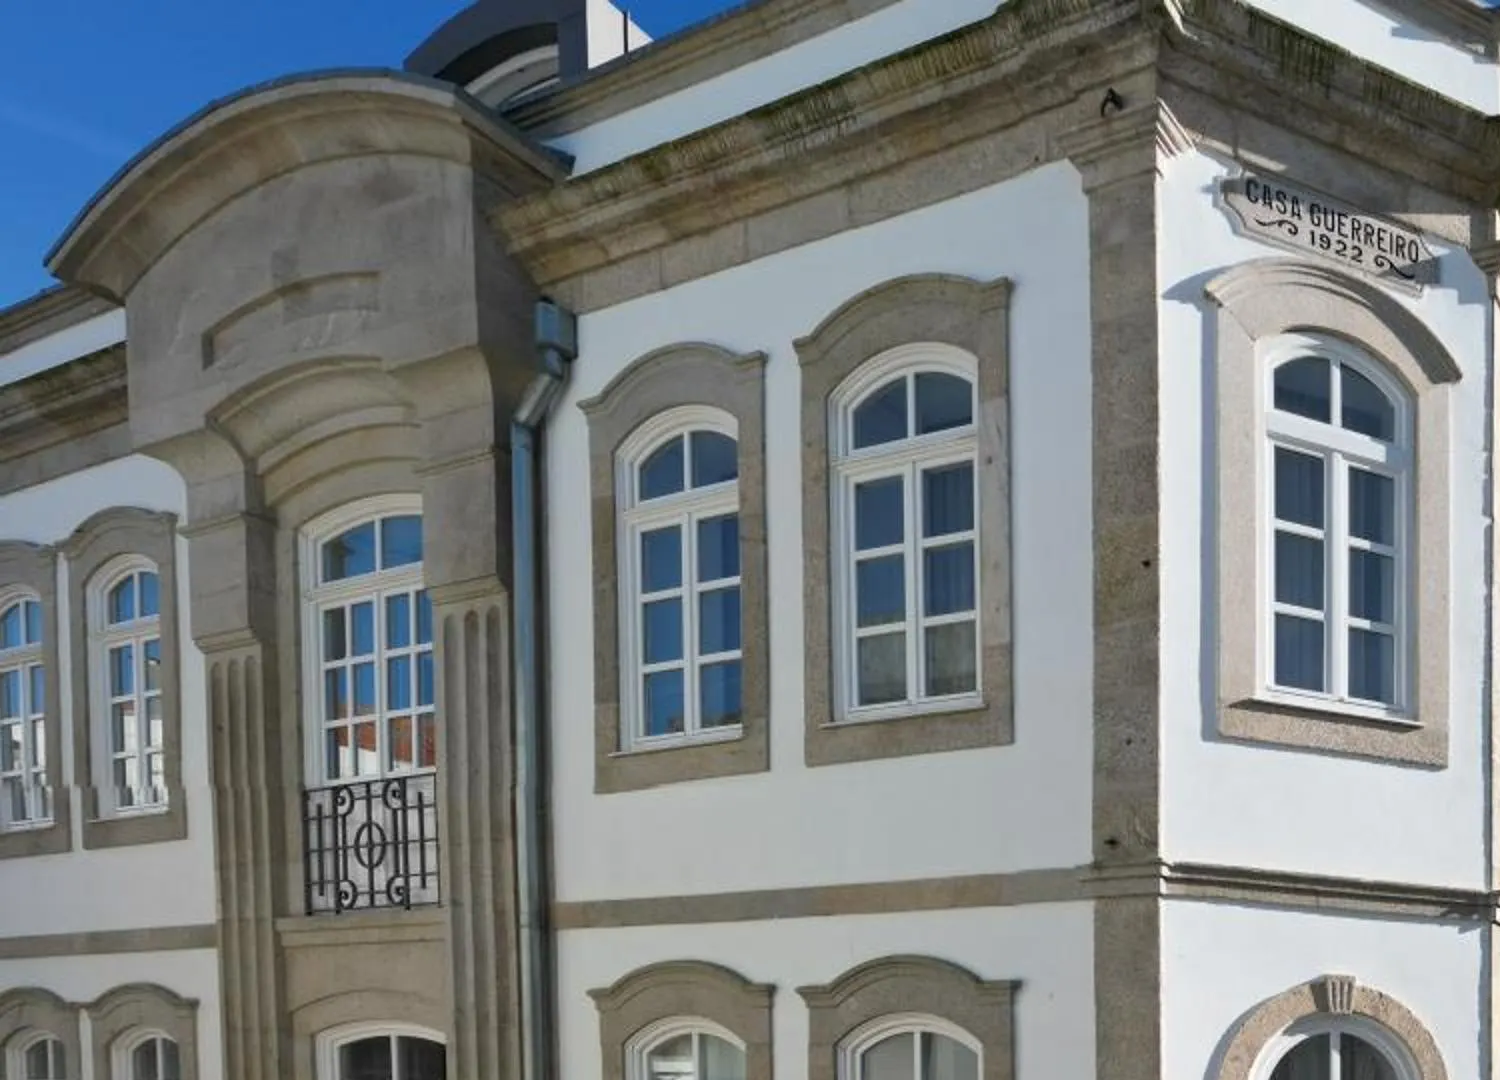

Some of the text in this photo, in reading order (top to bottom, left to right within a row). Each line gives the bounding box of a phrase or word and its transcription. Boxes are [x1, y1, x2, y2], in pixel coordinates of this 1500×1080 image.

[1246, 178, 1420, 263] CASA GUERREIRO
[1309, 230, 1363, 263] 1922
